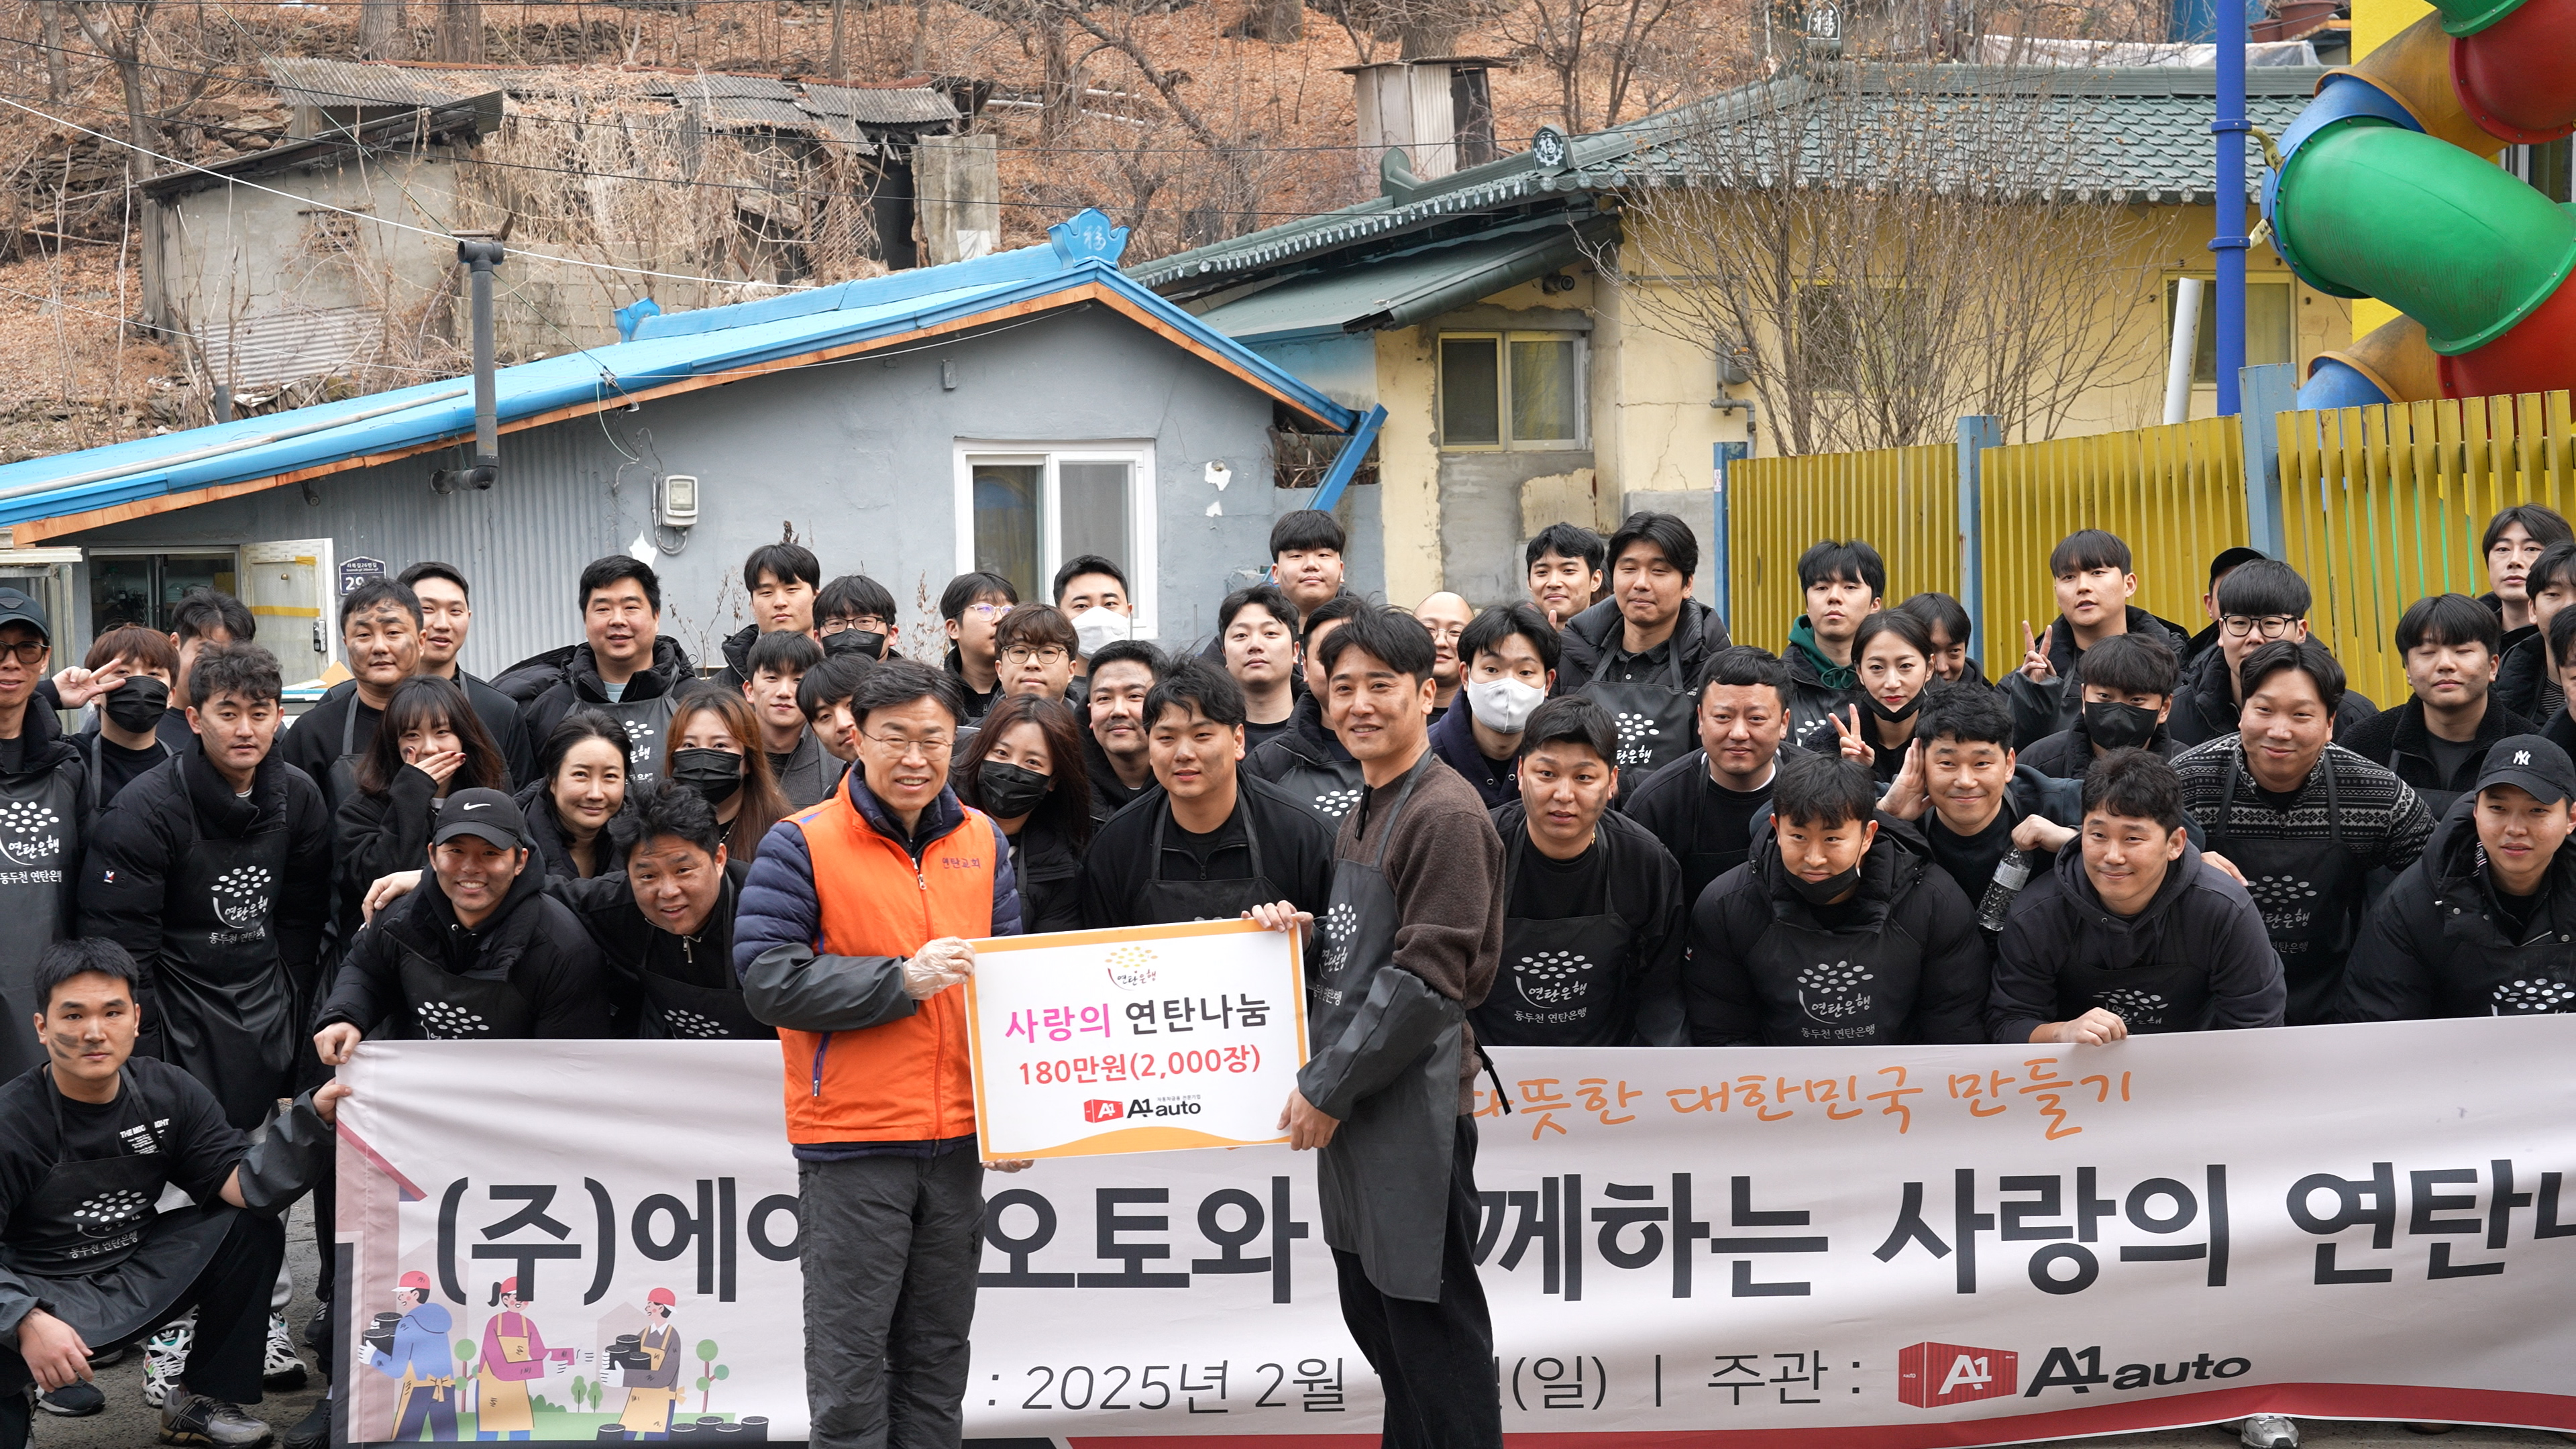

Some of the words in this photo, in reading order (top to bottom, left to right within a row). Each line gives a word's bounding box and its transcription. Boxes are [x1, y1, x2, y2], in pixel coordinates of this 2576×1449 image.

[1083, 225, 1106, 251] 福
[630, 745, 651, 763] 은행
[1616, 745, 1652, 765] 탄은행
[8, 835, 60, 859] 연탄은행
[942, 857, 981, 869] 연탄교회
[0, 871, 29, 885] 동두천
[30, 869, 62, 883] 연탄은행
[224, 895, 268, 921] 연탄은행
[2261, 908, 2310, 929] 탄은행
[209, 932, 237, 945] 동두천
[1117, 969, 1157, 986] 연탄은행
[1528, 980, 1588, 1003] 연탄은행
[1514, 1010, 1544, 1024] 동두천
[1548, 1007, 1587, 1024] 연탄은행
[1811, 993, 1871, 1018] 연탄은행
[1006, 1004, 1110, 1043] 사랑의
[1126, 994, 1270, 1035] 연탄나눔
[1801, 1027, 1831, 1039] 동두천
[1834, 1024, 1876, 1039] 연탄은행
[1019, 1044, 1260, 1085] 180만원(2,000장)
[1156, 1101, 1201, 1116] auto
[1666, 1066, 1923, 1134] 대한민국
[1947, 1057, 2131, 1141] 만들기
[119, 1129, 133, 1138] THE
[1474, 1173, 1828, 1301] 께하는
[1872, 1164, 2229, 1295] 사랑의
[1022, 1360, 1228, 1414] 2025년
[1255, 1358, 1346, 1413] 2월
[1707, 1350, 1828, 1407] 주관
[2112, 1353, 2251, 1391] auto
